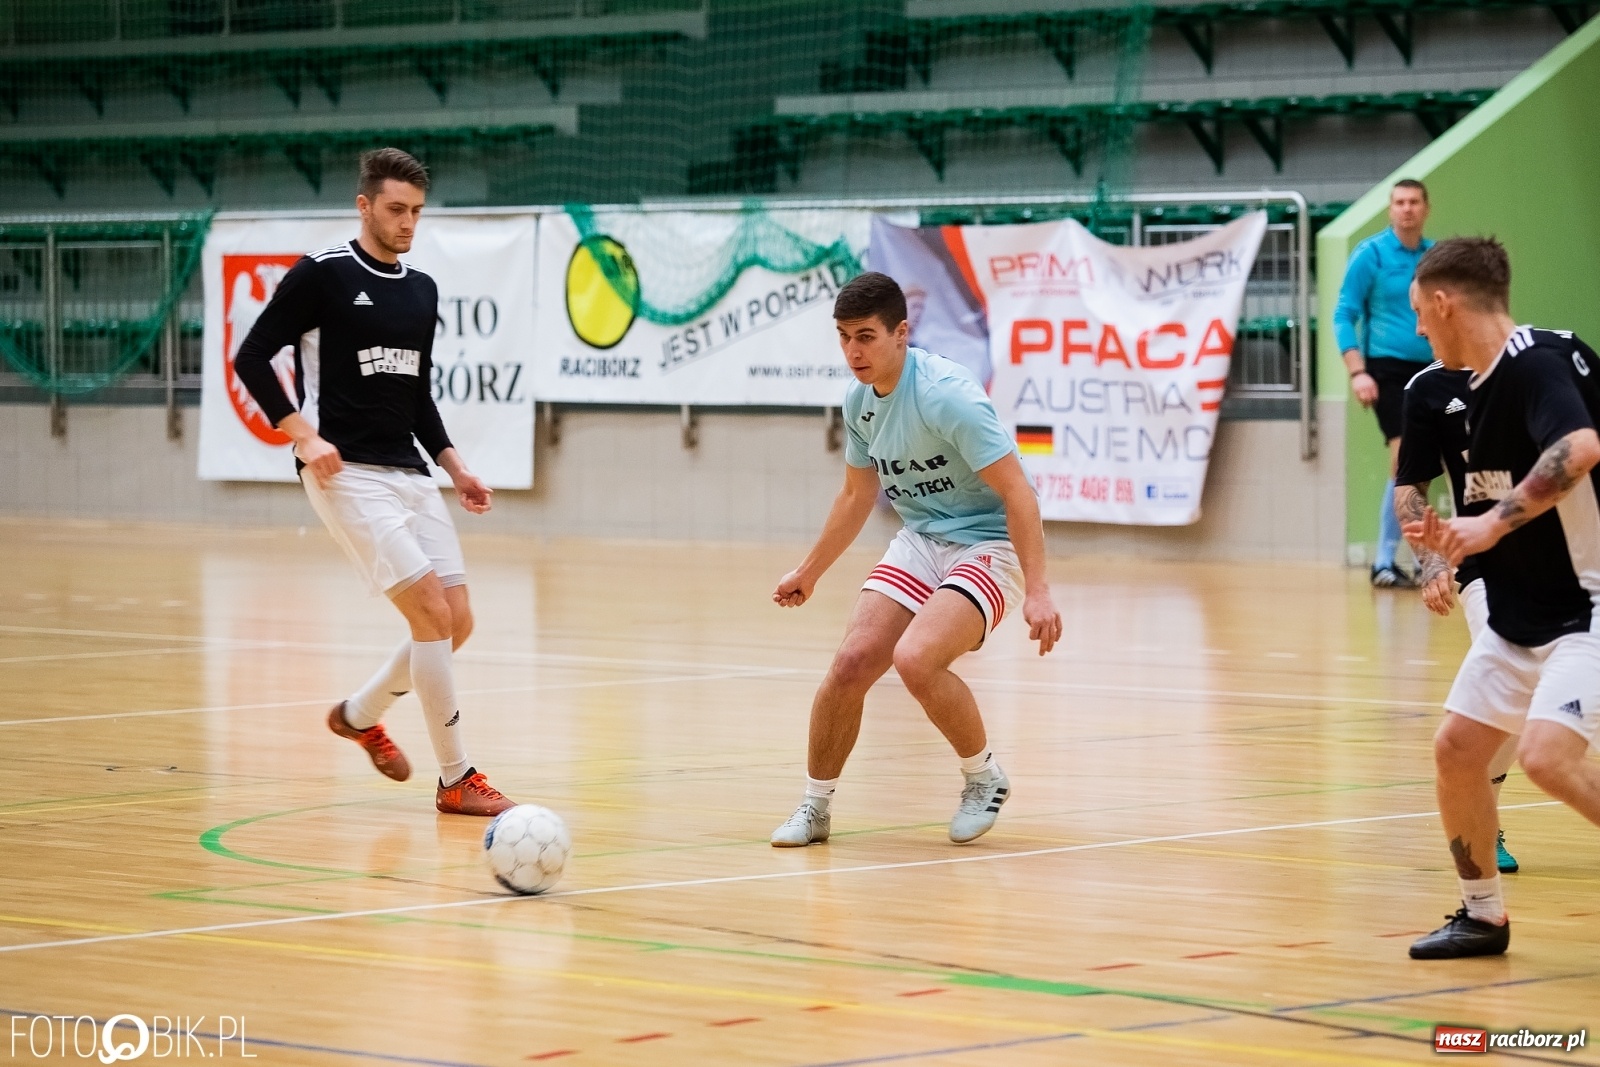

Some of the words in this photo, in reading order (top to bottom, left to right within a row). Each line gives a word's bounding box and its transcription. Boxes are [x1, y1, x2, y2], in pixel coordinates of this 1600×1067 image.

[659, 320, 713, 368] JEST
[719, 307, 743, 340] W
[1013, 376, 1193, 416] AUSTRIA
